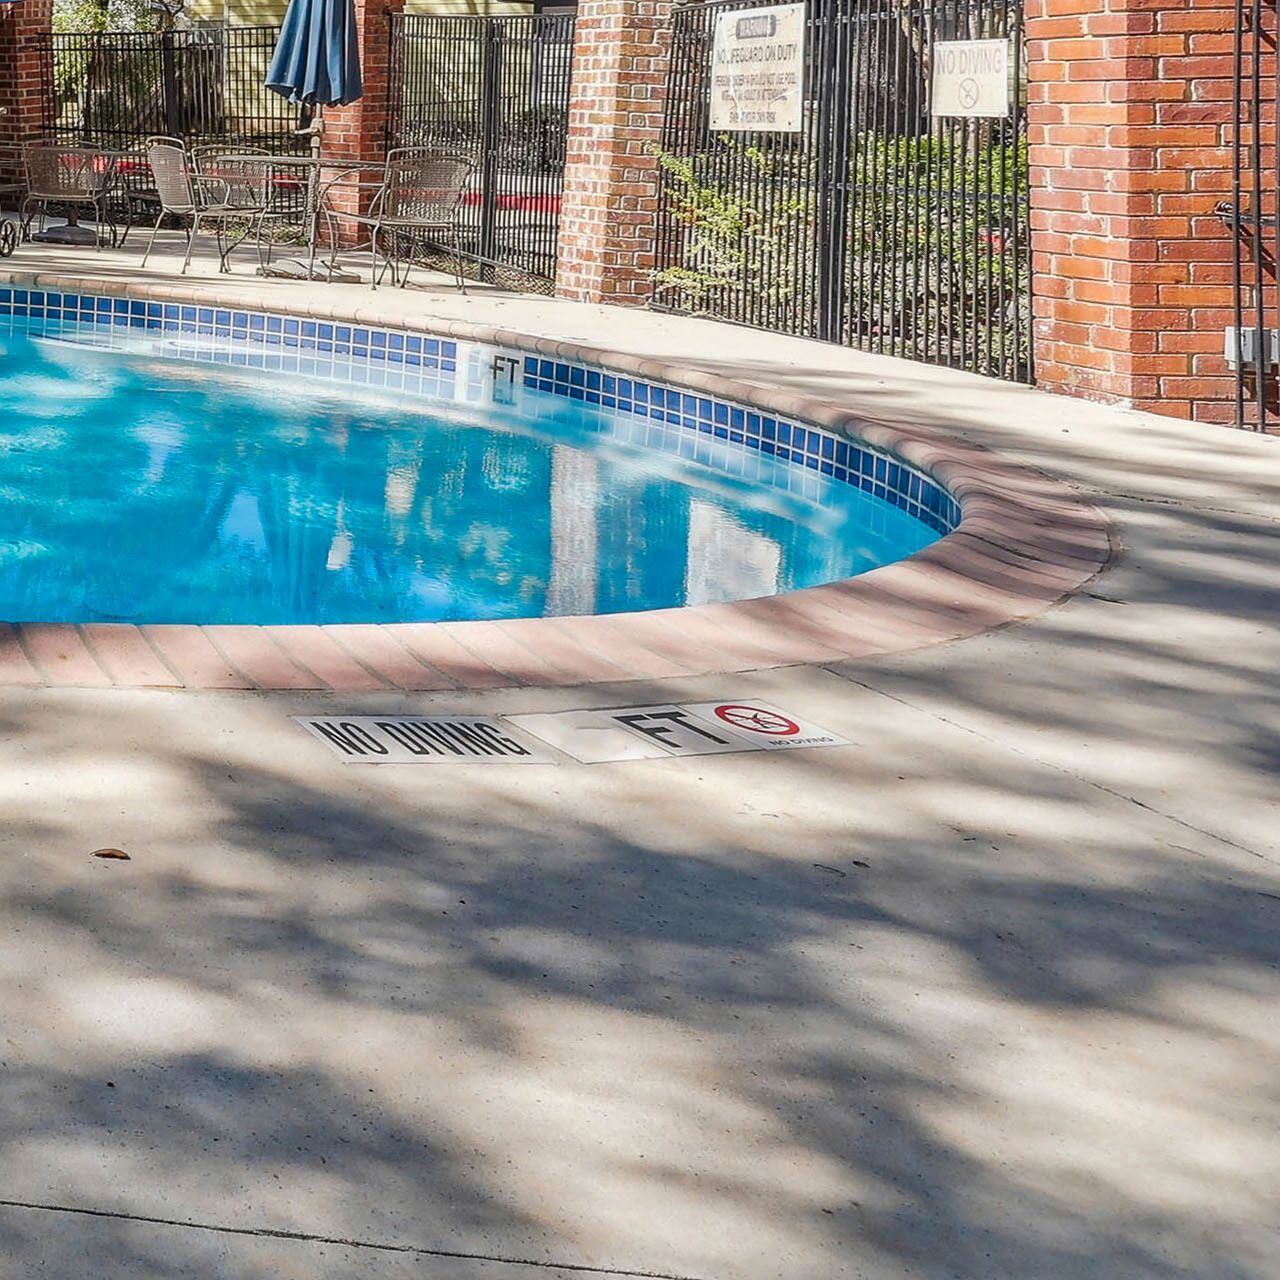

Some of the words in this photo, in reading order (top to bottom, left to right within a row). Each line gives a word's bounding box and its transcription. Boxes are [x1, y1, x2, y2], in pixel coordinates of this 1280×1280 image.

[937, 50, 956, 75] NO
[959, 48, 1004, 75] DIVING
[489, 355, 520, 383] FT
[309, 721, 389, 755] NO
[373, 721, 532, 756] DIVING
[611, 711, 730, 748] FT
[790, 737, 834, 745] DIVING
